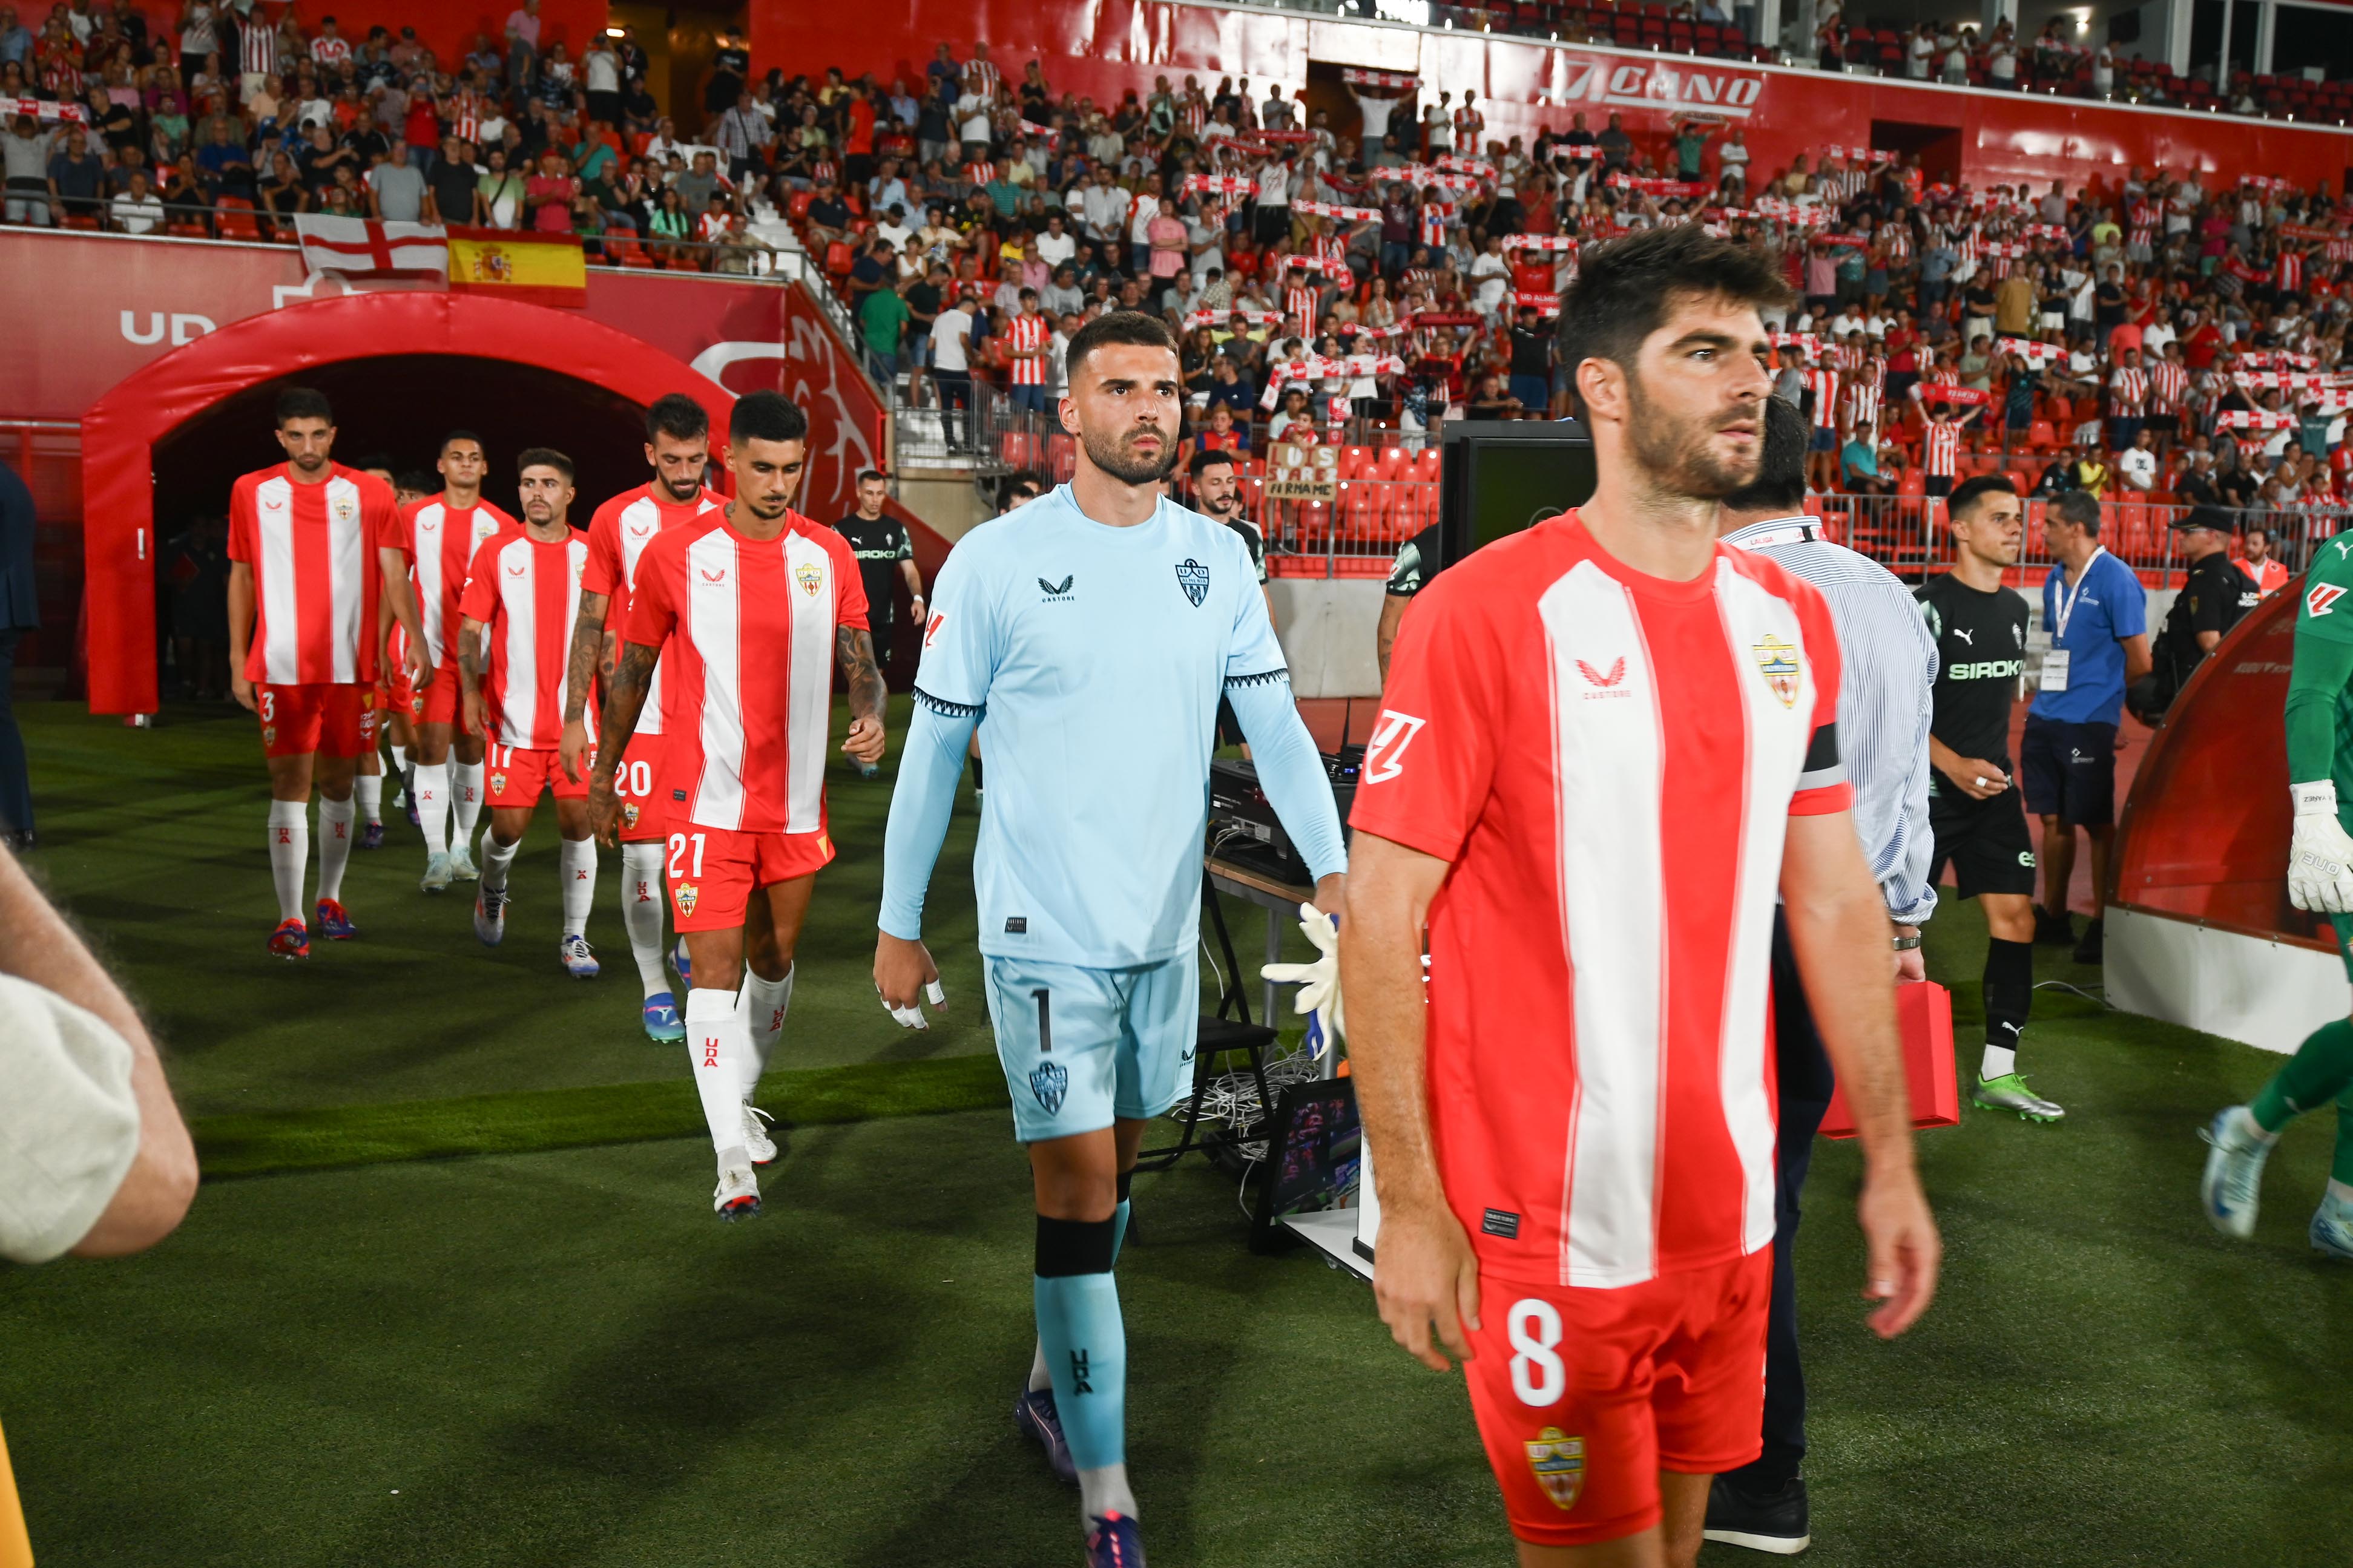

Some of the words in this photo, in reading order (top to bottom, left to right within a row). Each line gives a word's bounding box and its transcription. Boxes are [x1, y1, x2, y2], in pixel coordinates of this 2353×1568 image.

[121, 310, 217, 346] UD
[1271, 446, 1334, 467] LUIS
[1750, 536, 1774, 545] LALIGA
[1949, 660, 2024, 680] SIROK
[262, 691, 275, 723] 3
[614, 760, 651, 797] 20
[669, 833, 706, 879] 21
[637, 881, 651, 903] UDA
[1030, 987, 1052, 1054] 1
[703, 1037, 719, 1068] UDA
[1507, 1298, 1566, 1407] 8
[1070, 1349, 1094, 1397] UDA
